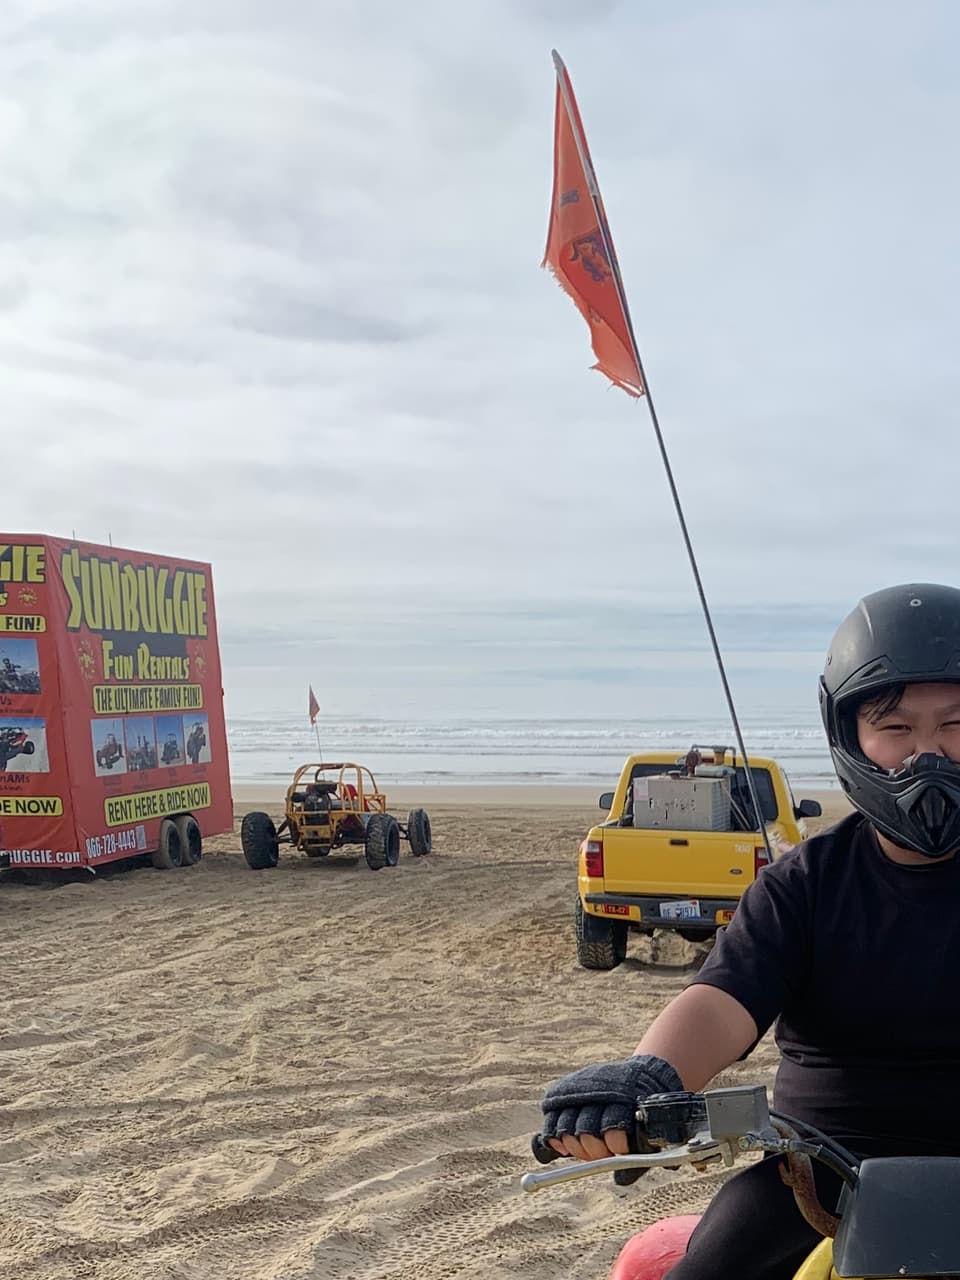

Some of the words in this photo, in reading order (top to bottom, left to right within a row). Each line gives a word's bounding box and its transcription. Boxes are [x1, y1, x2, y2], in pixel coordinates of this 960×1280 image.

[61, 547, 208, 637] SUNBUGGIE
[5, 616, 41, 631] FUN!
[95, 687, 112, 712] THE
[115, 687, 153, 711] ULTIMATE
[154, 687, 182, 709] FAMILY
[183, 686, 201, 707] FUN!
[15, 799, 57, 814] NOW
[107, 798, 133, 823] RENT
[133, 796, 158, 818] HERE
[159, 795, 166, 814] &
[166, 790, 187, 813] RIDE
[187, 786, 209, 808] NOW
[85, 829, 136, 859] 866-728-4443
